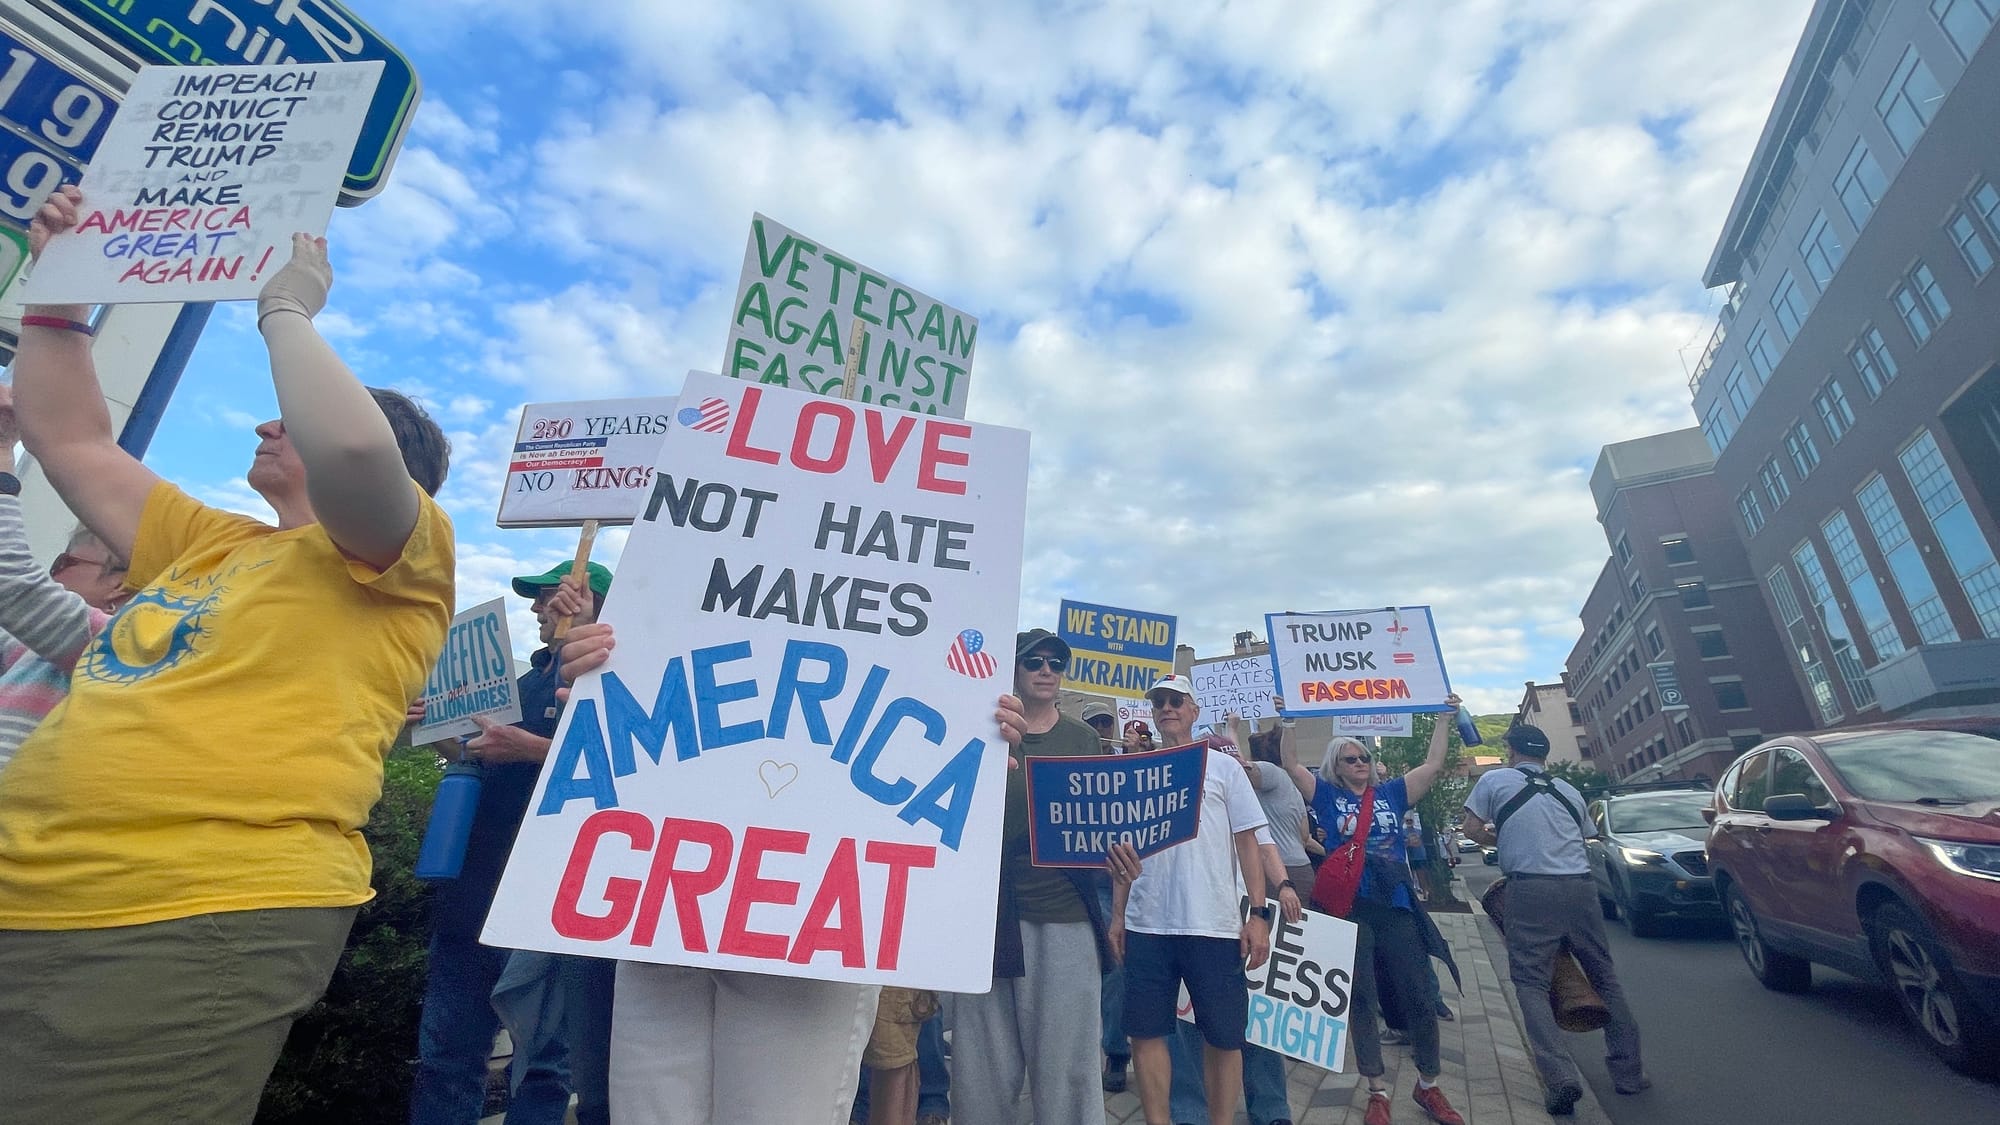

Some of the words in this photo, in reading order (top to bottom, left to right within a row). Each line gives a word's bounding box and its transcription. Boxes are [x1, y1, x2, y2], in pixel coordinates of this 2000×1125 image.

[173, 71, 317, 97] IMPEACH
[157, 97, 307, 121] CONVICT
[151, 121, 287, 143] REMOVE
[144, 145, 277, 168] TRUMP
[177, 169, 229, 182] AND
[134, 184, 243, 207] MAKE
[76, 206, 251, 234] AMERICA
[104, 231, 236, 258] GREAT
[752, 219, 977, 359] VETERAN
[737, 282, 967, 406] AGAINST
[532, 417, 574, 440] 250
[585, 415, 668, 436] YEARS
[726, 386, 973, 495] LOVE
[543, 458, 587, 468] Democracy!
[560, 449, 587, 459] Enemy
[517, 472, 554, 493] NO
[643, 472, 779, 539] NOT
[814, 501, 974, 571] HATE
[700, 557, 933, 636] MAKES
[1067, 607, 1097, 636] WE
[1101, 613, 1170, 646] STAND
[1286, 621, 1372, 643] TRUMP
[1108, 641, 1124, 652] WITH
[1066, 656, 1159, 691] UKRAINE
[1213, 658, 1260, 673] LABOR
[1306, 651, 1377, 672] MUSK
[1195, 668, 1274, 692] CREATES
[1301, 679, 1411, 703] FASCISM
[1196, 690, 1272, 709] OLIGARCHY
[536, 639, 986, 852] AMERICA
[1068, 771, 1126, 796] STOP
[1134, 764, 1173, 793] THE
[1050, 787, 1190, 825] BILLIONAIRE
[1061, 820, 1172, 853] TAKEOVER
[551, 810, 936, 971] GREAT
[1246, 994, 1346, 1069] RIGHT
